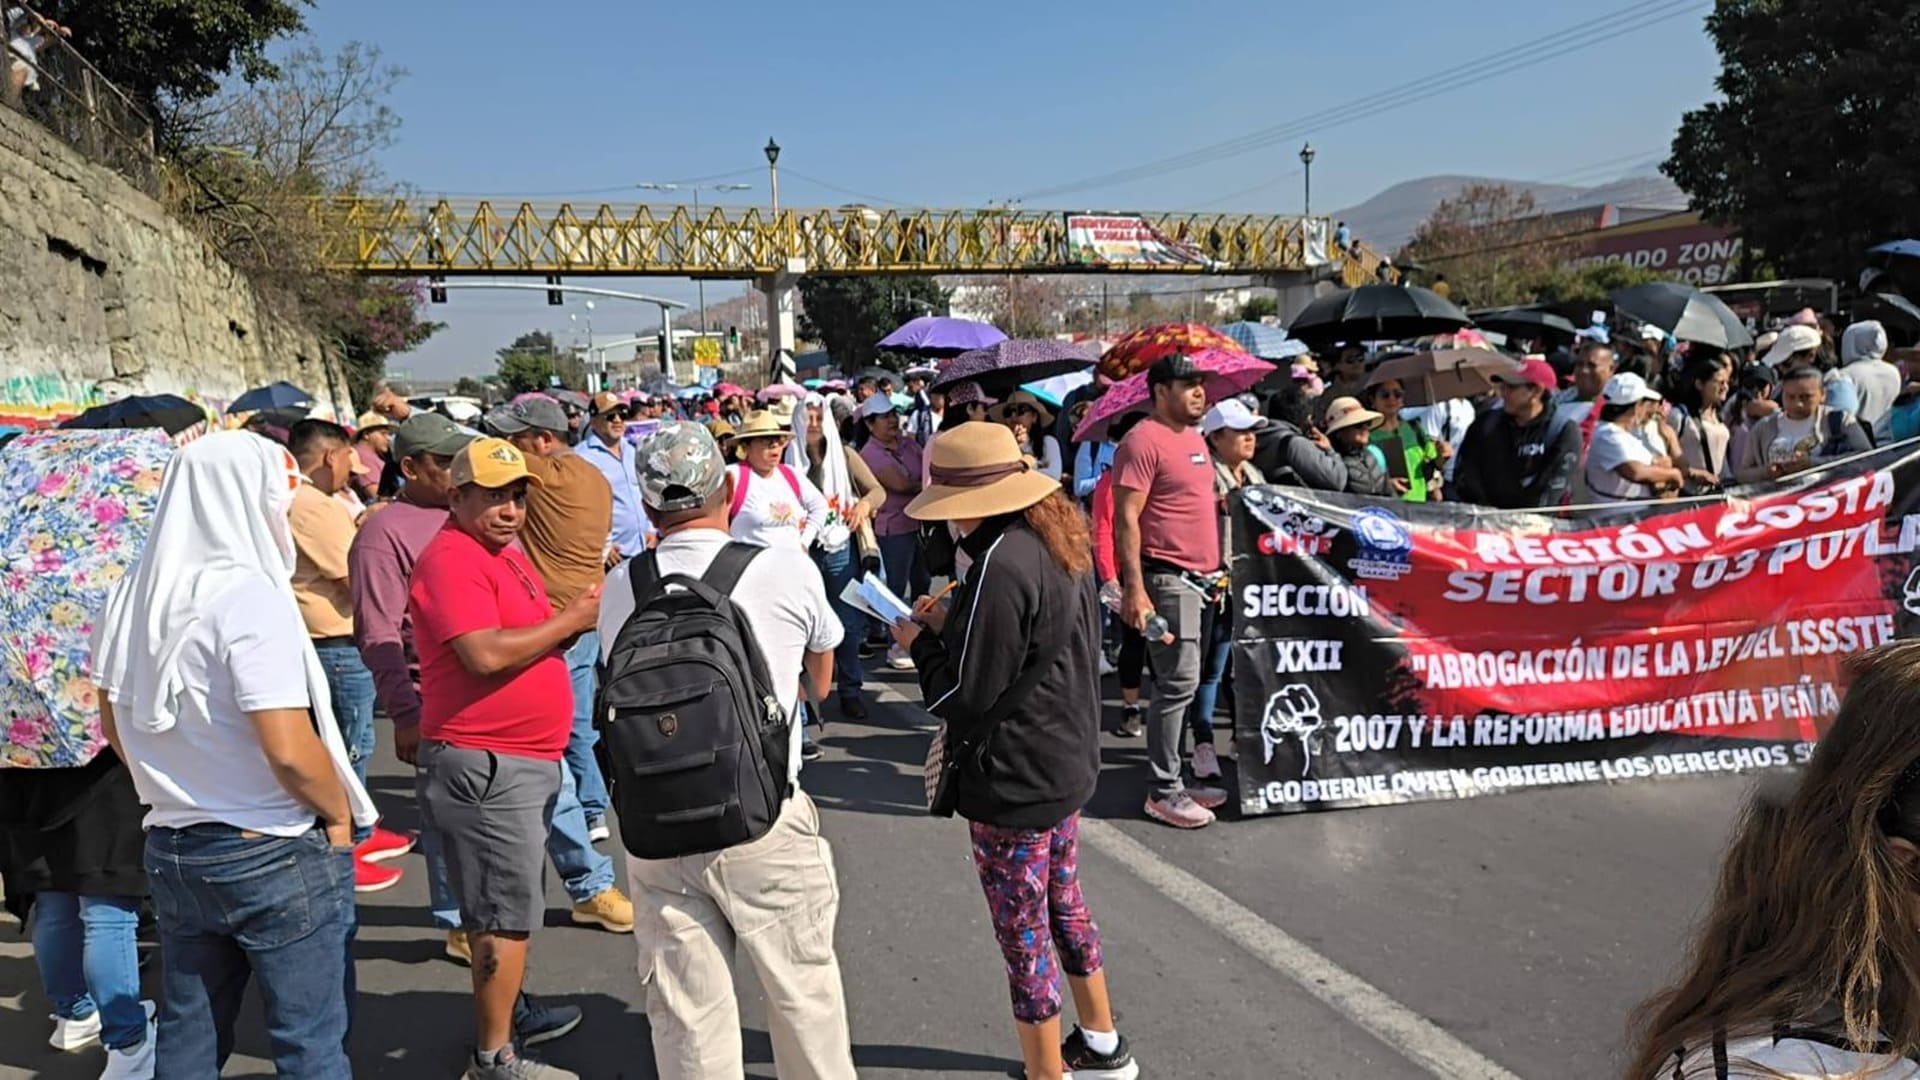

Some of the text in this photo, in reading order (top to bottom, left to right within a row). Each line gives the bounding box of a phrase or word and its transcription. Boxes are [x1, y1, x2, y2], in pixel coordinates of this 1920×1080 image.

[1474, 523, 1711, 564] REGIÓN
[1717, 471, 1894, 538] COSTA
[1443, 562, 1680, 604] SECTOR
[1692, 549, 1759, 588] 03
[1276, 640, 1342, 673] XXII
[1612, 643, 1649, 679] DE
[1655, 640, 1690, 677] LA
[1695, 635, 1743, 673] LEY
[1787, 614, 1895, 655] ISSSTE
[1334, 674, 1840, 752] 2007 Y LA REFORMA EDUCATIVA PEÑA
[1259, 774, 1386, 809] ¡GOBIERNE
[1472, 761, 1601, 791] GOBIERNE
[1602, 755, 1652, 779] LOS
[1653, 745, 1789, 775] DERECHOS
[1793, 742, 1817, 764] S
